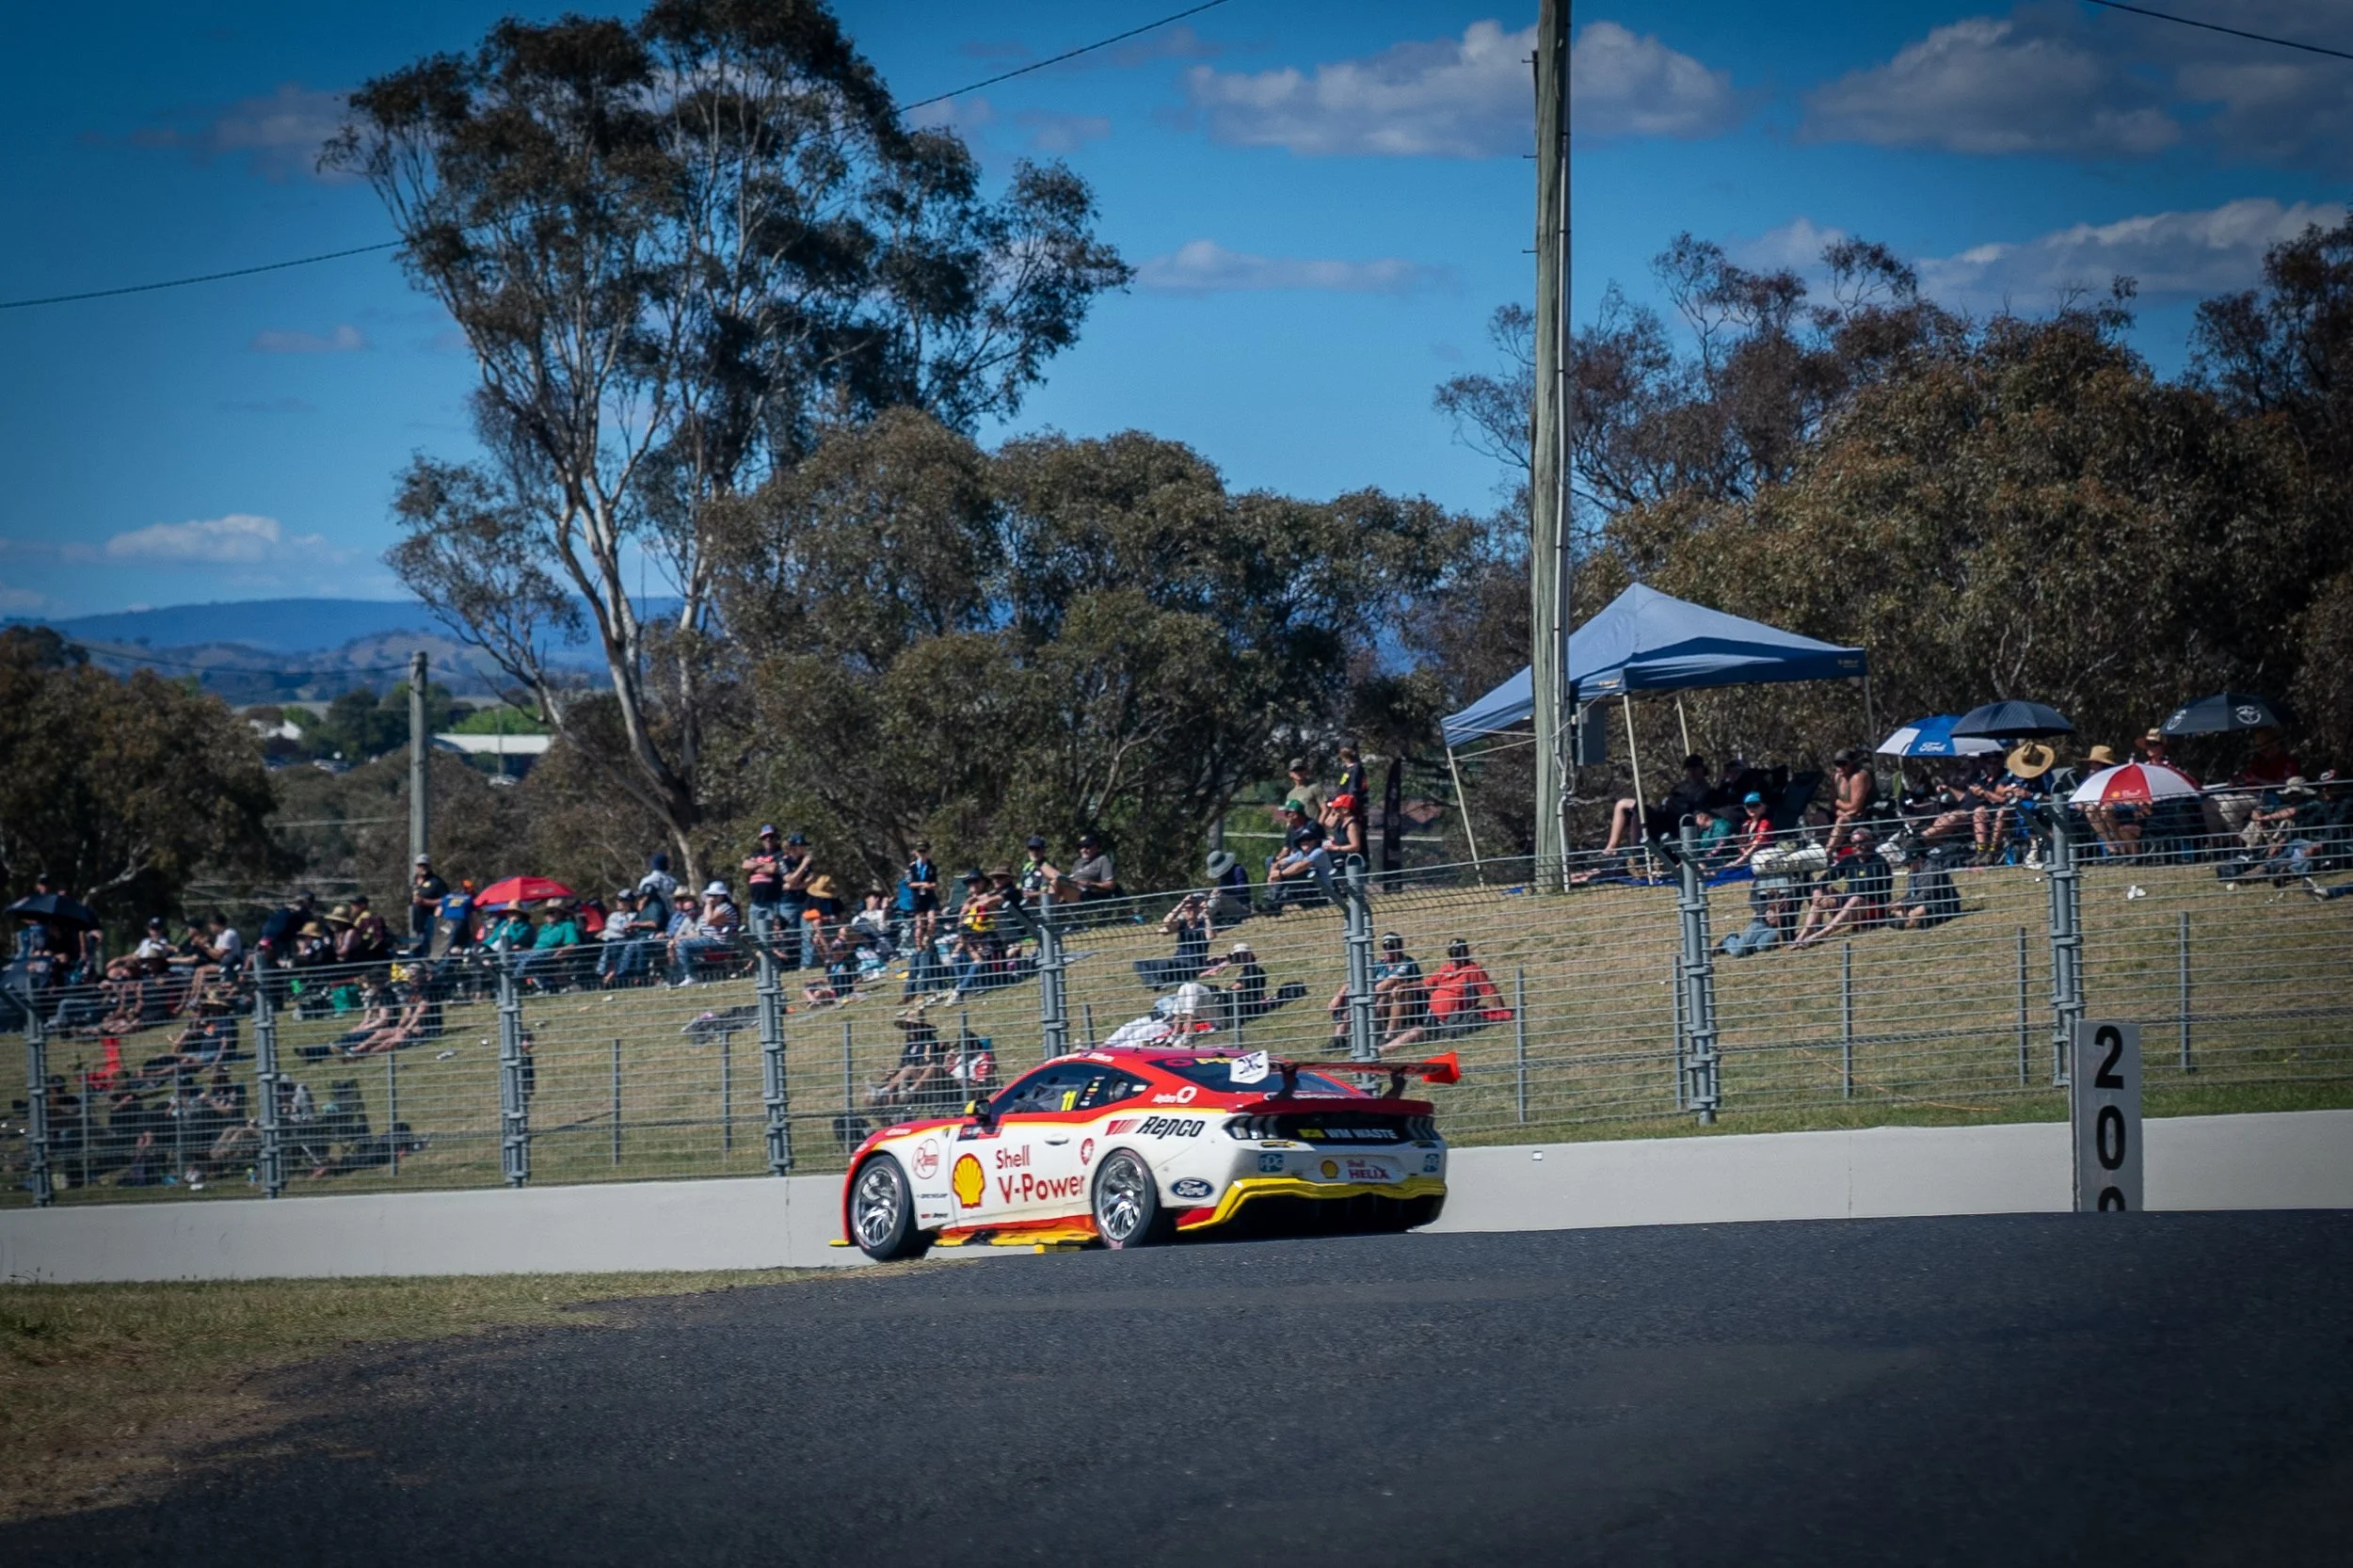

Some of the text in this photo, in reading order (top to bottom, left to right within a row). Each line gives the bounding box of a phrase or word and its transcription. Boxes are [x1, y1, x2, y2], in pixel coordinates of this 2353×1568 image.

[1918, 742, 1947, 752] Ford
[1061, 1091, 1077, 1111] 11
[1135, 1116, 1206, 1140] Repco
[996, 1144, 1031, 1169] Shell
[998, 1173, 1085, 1204] V-Power
[1176, 1180, 1208, 1196] Ford
